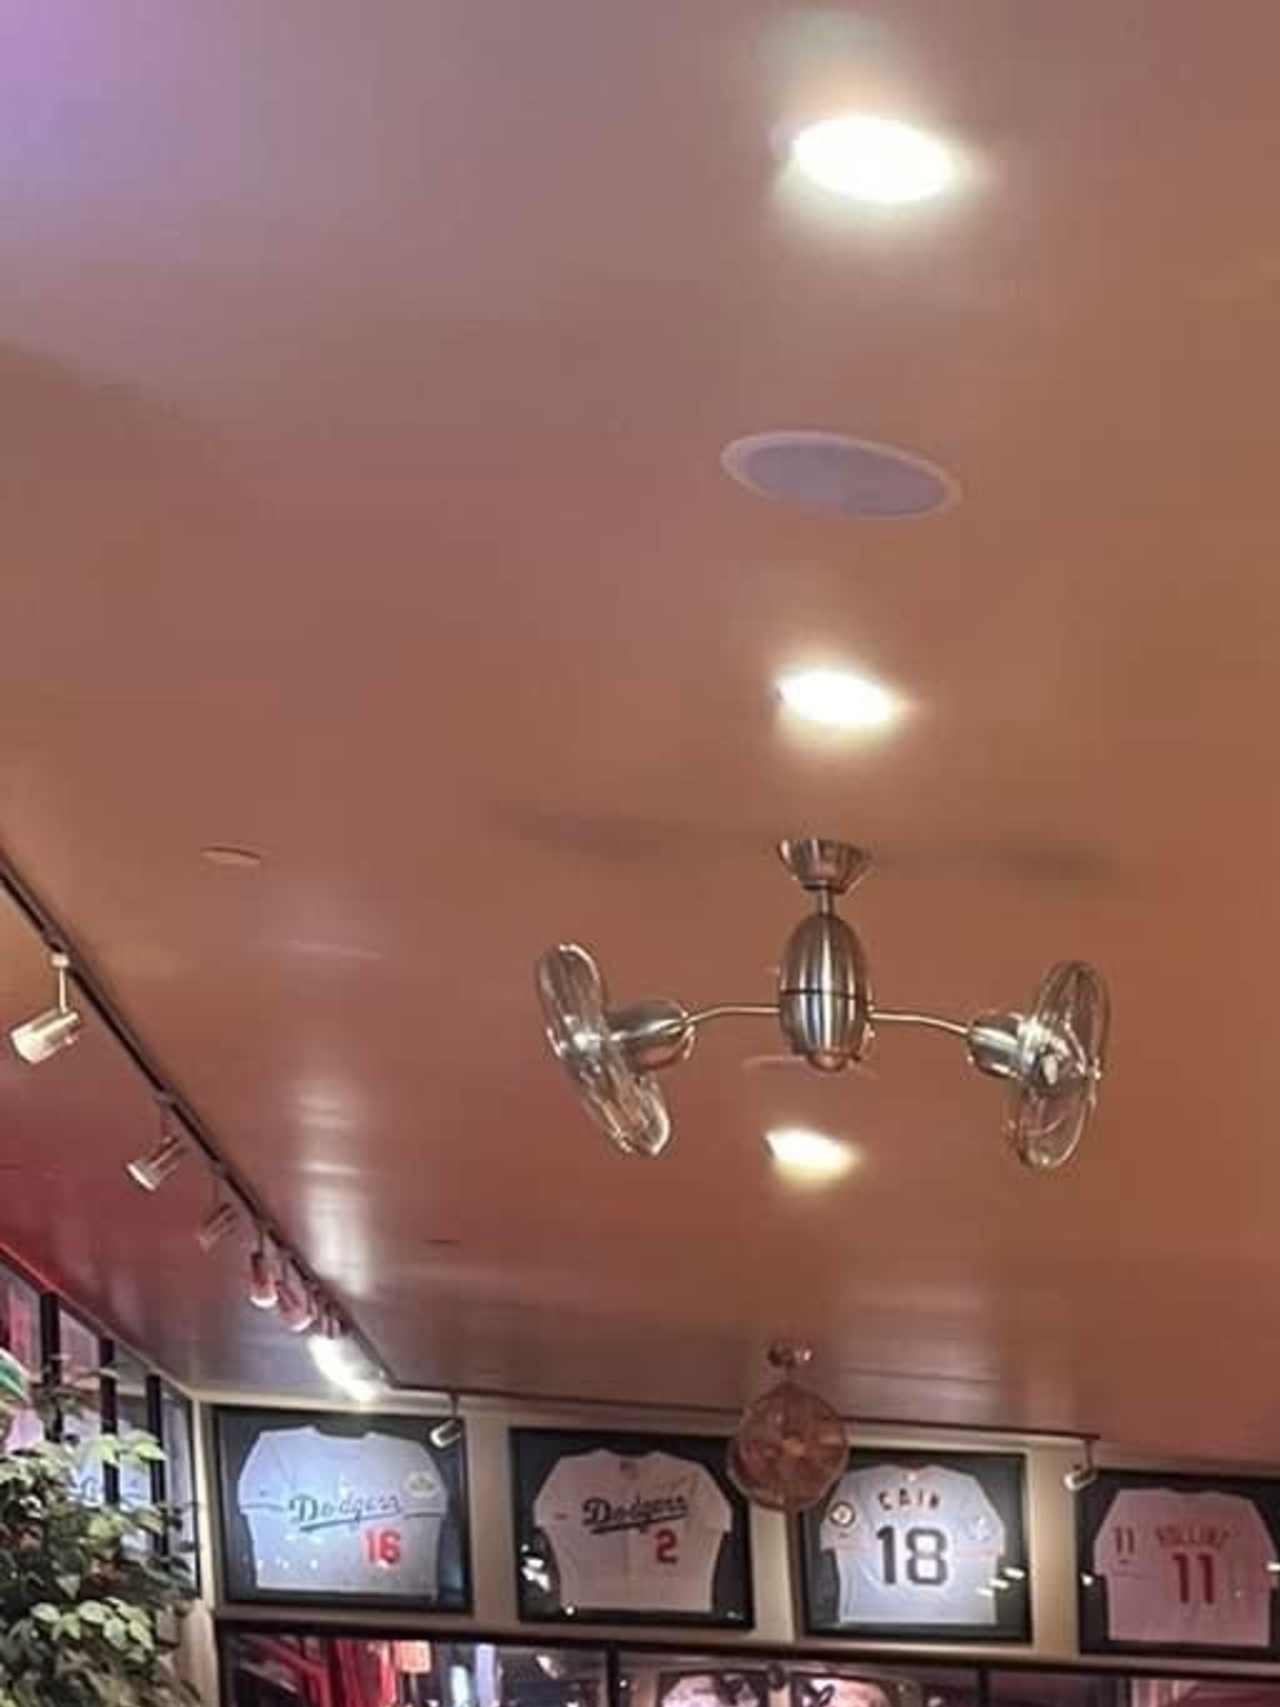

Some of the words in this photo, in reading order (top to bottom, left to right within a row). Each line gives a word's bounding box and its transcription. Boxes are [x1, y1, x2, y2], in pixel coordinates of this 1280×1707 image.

[287, 1493, 402, 1533] Dodgers
[582, 1495, 688, 1534] Dodgers
[365, 1529, 402, 1564] 16
[655, 1528, 678, 1563] 2
[876, 1526, 948, 1584] 18
[1172, 1552, 1214, 1605] 11
